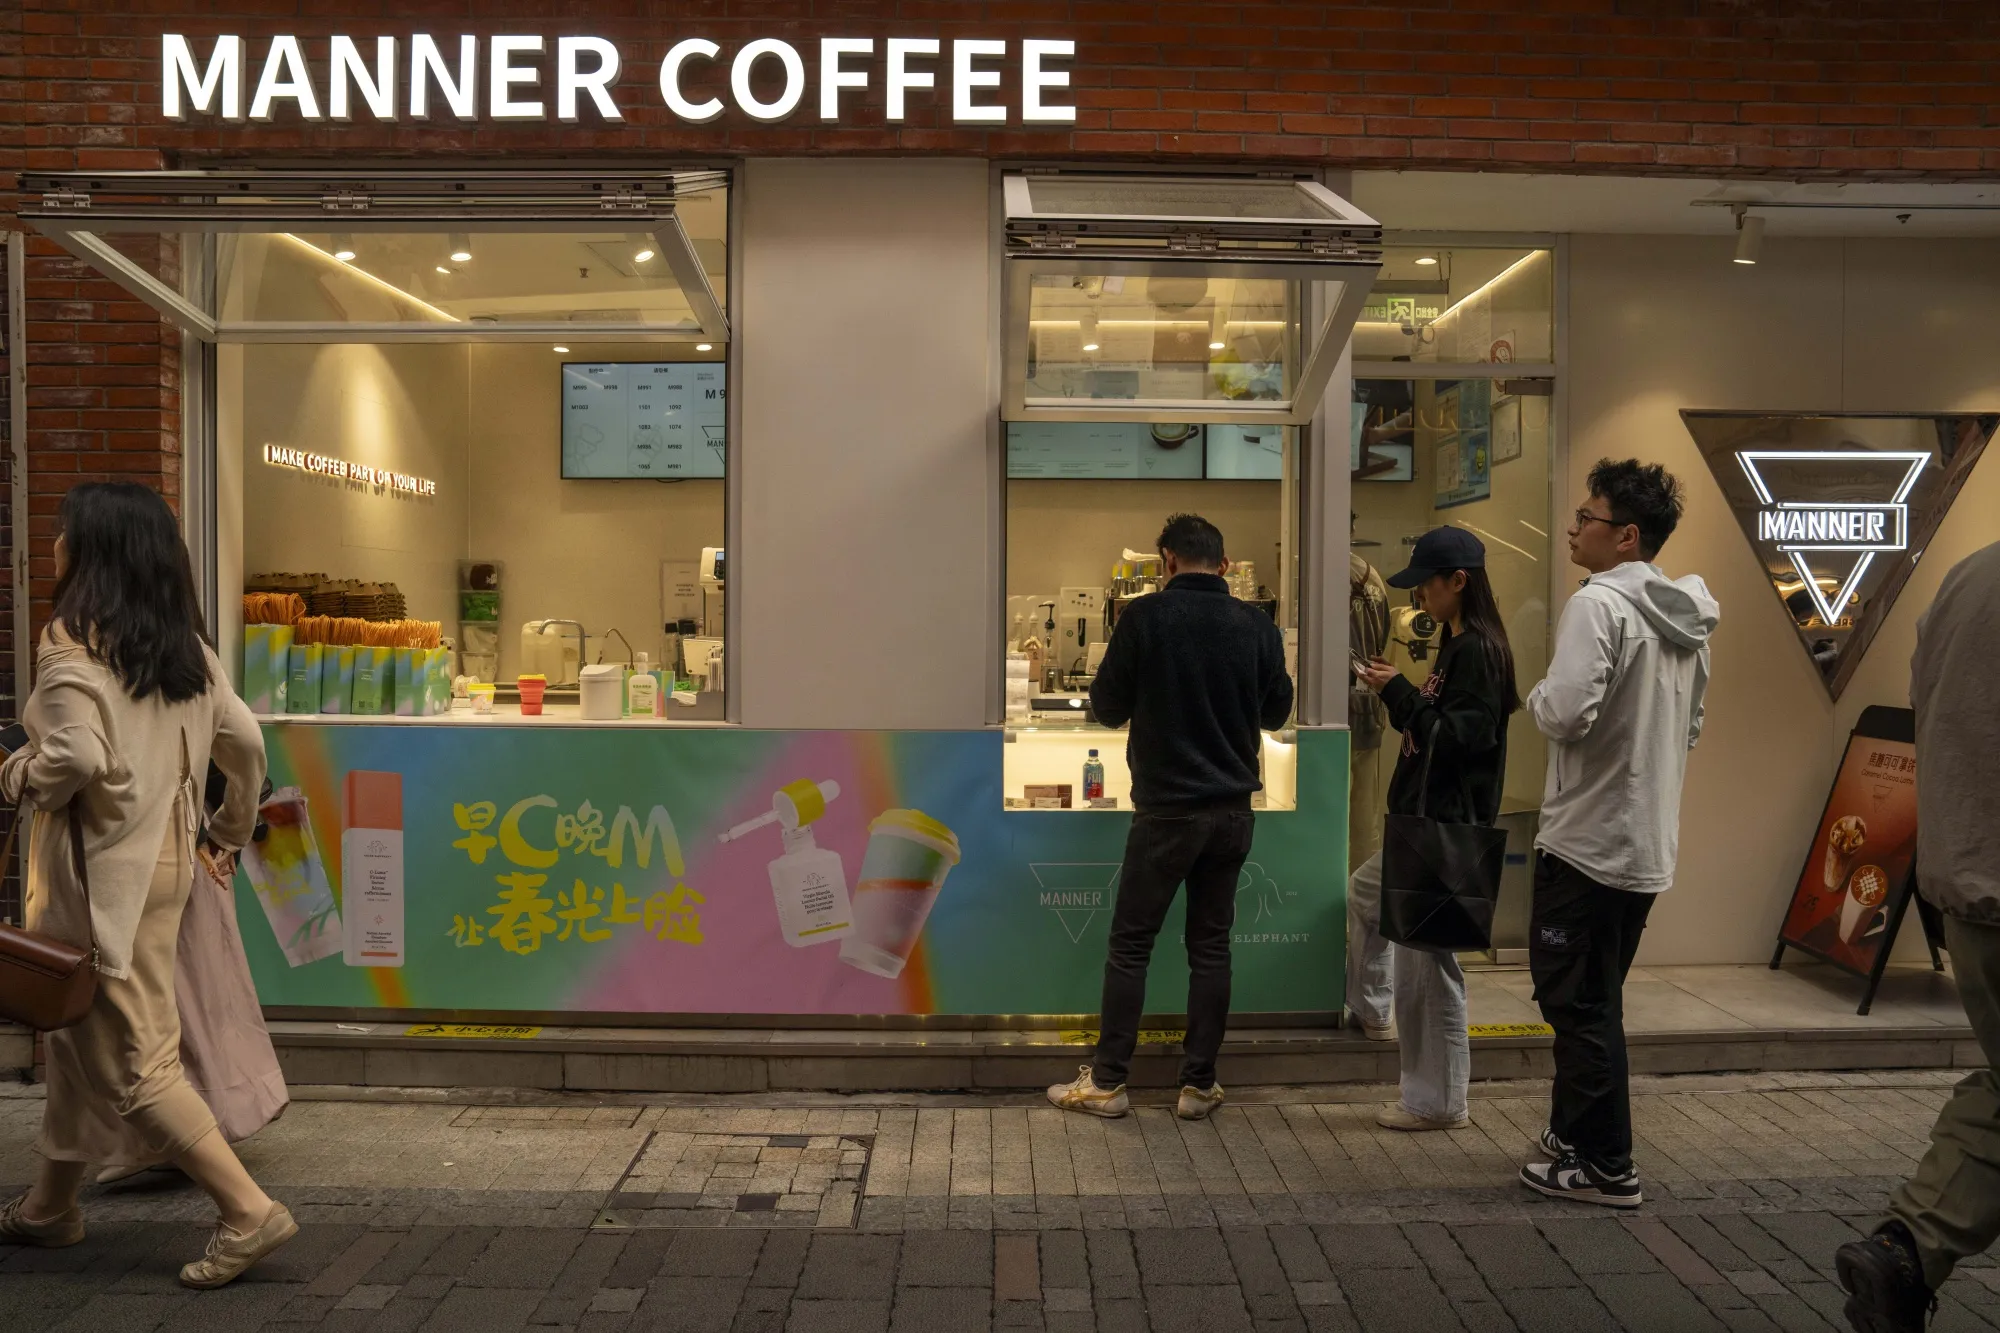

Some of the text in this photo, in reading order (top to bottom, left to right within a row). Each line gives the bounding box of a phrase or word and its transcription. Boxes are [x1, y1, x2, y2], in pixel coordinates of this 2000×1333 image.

[162, 33, 1077, 124] MANNER COFFEE
[270, 446, 436, 495] MAKE COFFEE PART OF YOUR LIFE
[1760, 510, 1884, 541] MANNER
[1882, 772, 1899, 783] Cocoa
[1040, 891, 1102, 906] MANNER
[444, 871, 707, 956] 让春光上脸
[1234, 933, 1310, 943] ELEPHANT
[455, 1025, 533, 1035] 小心台阶
[1470, 1024, 1545, 1033] 小心台阶
